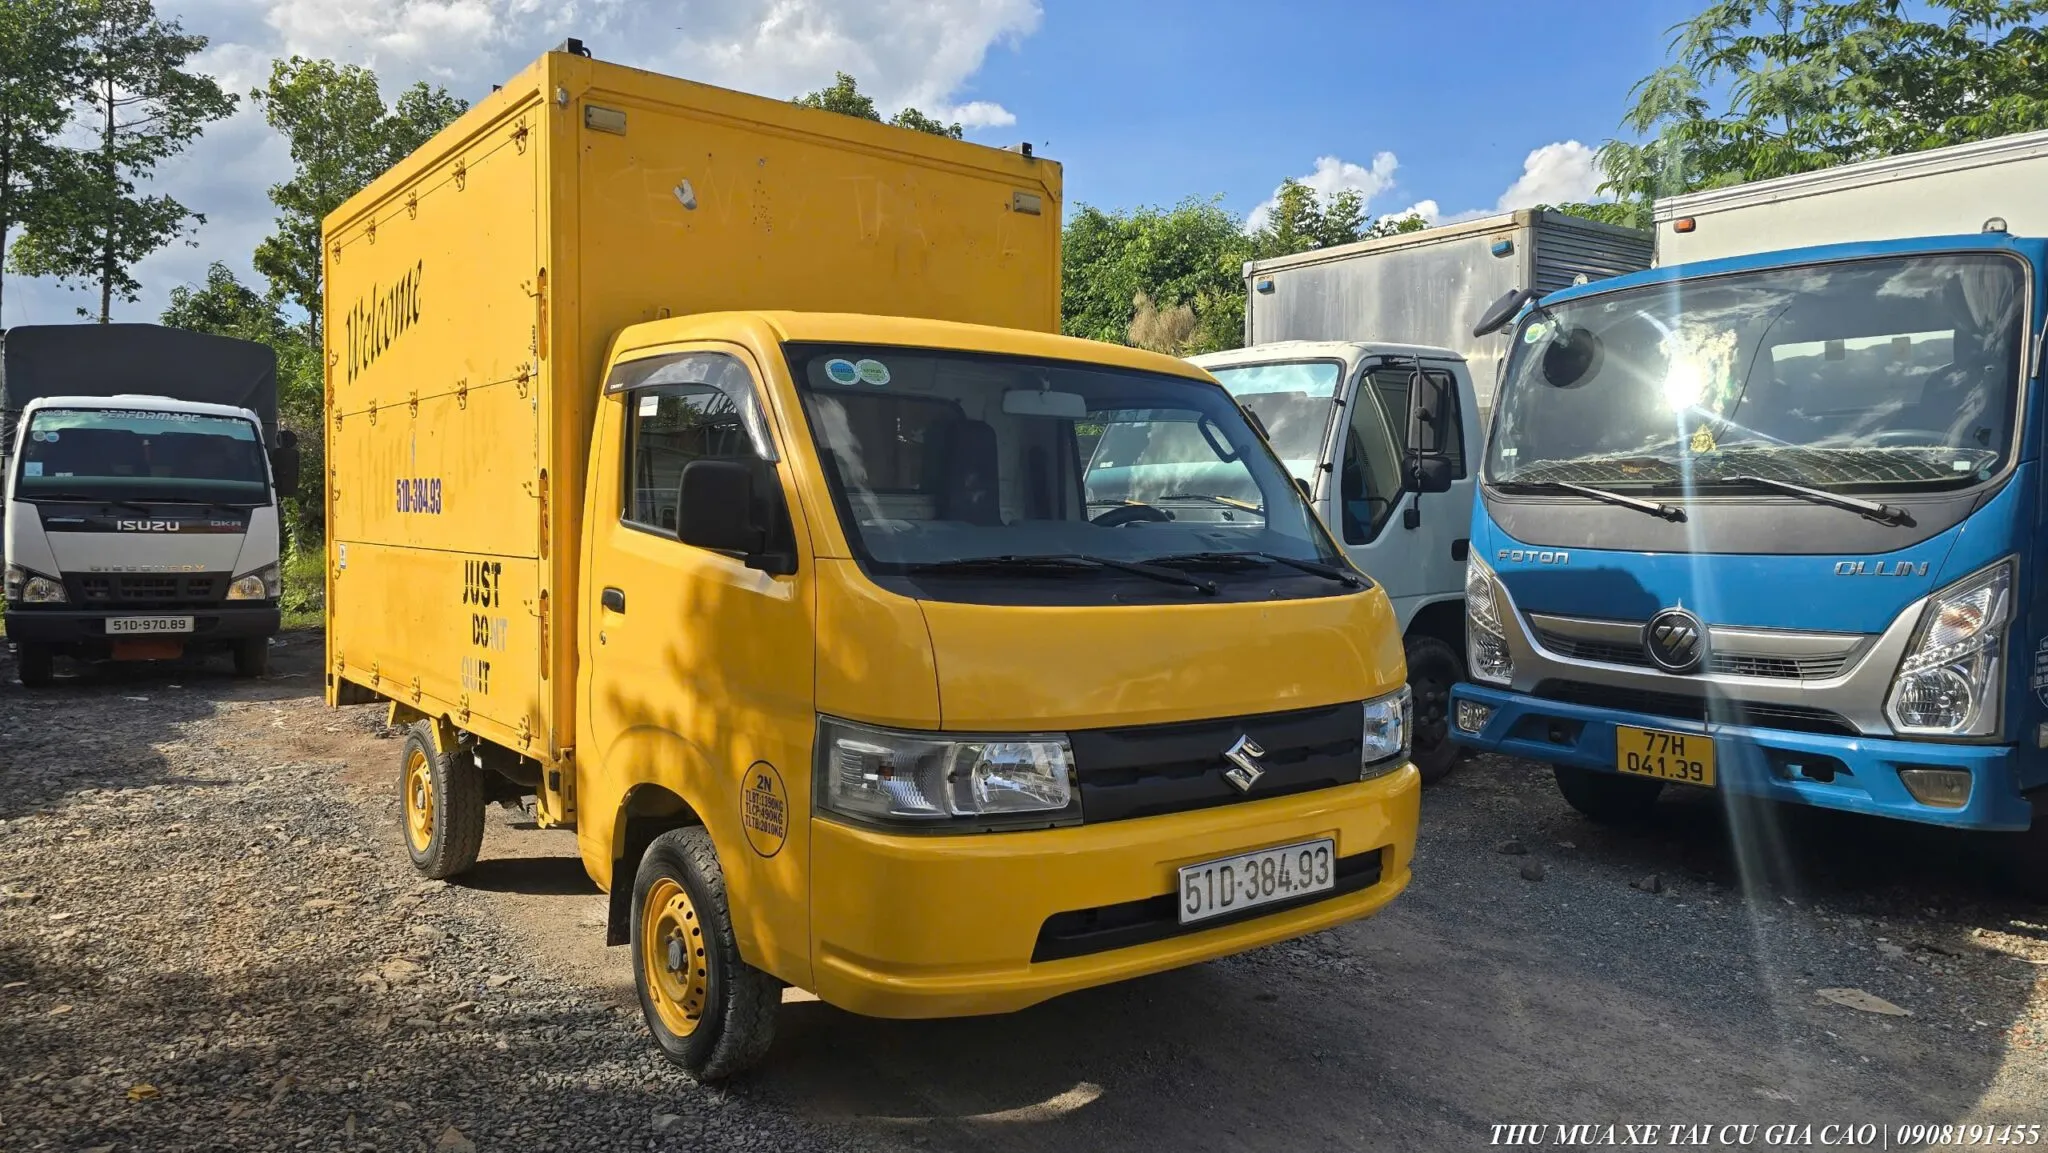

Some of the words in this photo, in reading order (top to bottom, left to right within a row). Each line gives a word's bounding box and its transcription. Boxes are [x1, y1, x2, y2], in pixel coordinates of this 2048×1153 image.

[345, 258, 422, 386] Welcome
[396, 478, 441, 515] 51D-384.93
[116, 520, 180, 531] ISUZU
[1498, 549, 1569, 564] FOTON
[1834, 561, 1929, 576] OLLIN
[463, 560, 501, 607] JUST
[113, 620, 186, 631] 51D-970.89
[461, 655, 490, 695] QUIT
[1643, 732, 1685, 756] 77H
[1627, 752, 1703, 781] 041.39
[757, 774, 772, 792] 2N
[1186, 847, 1329, 914] 51D-384.93
